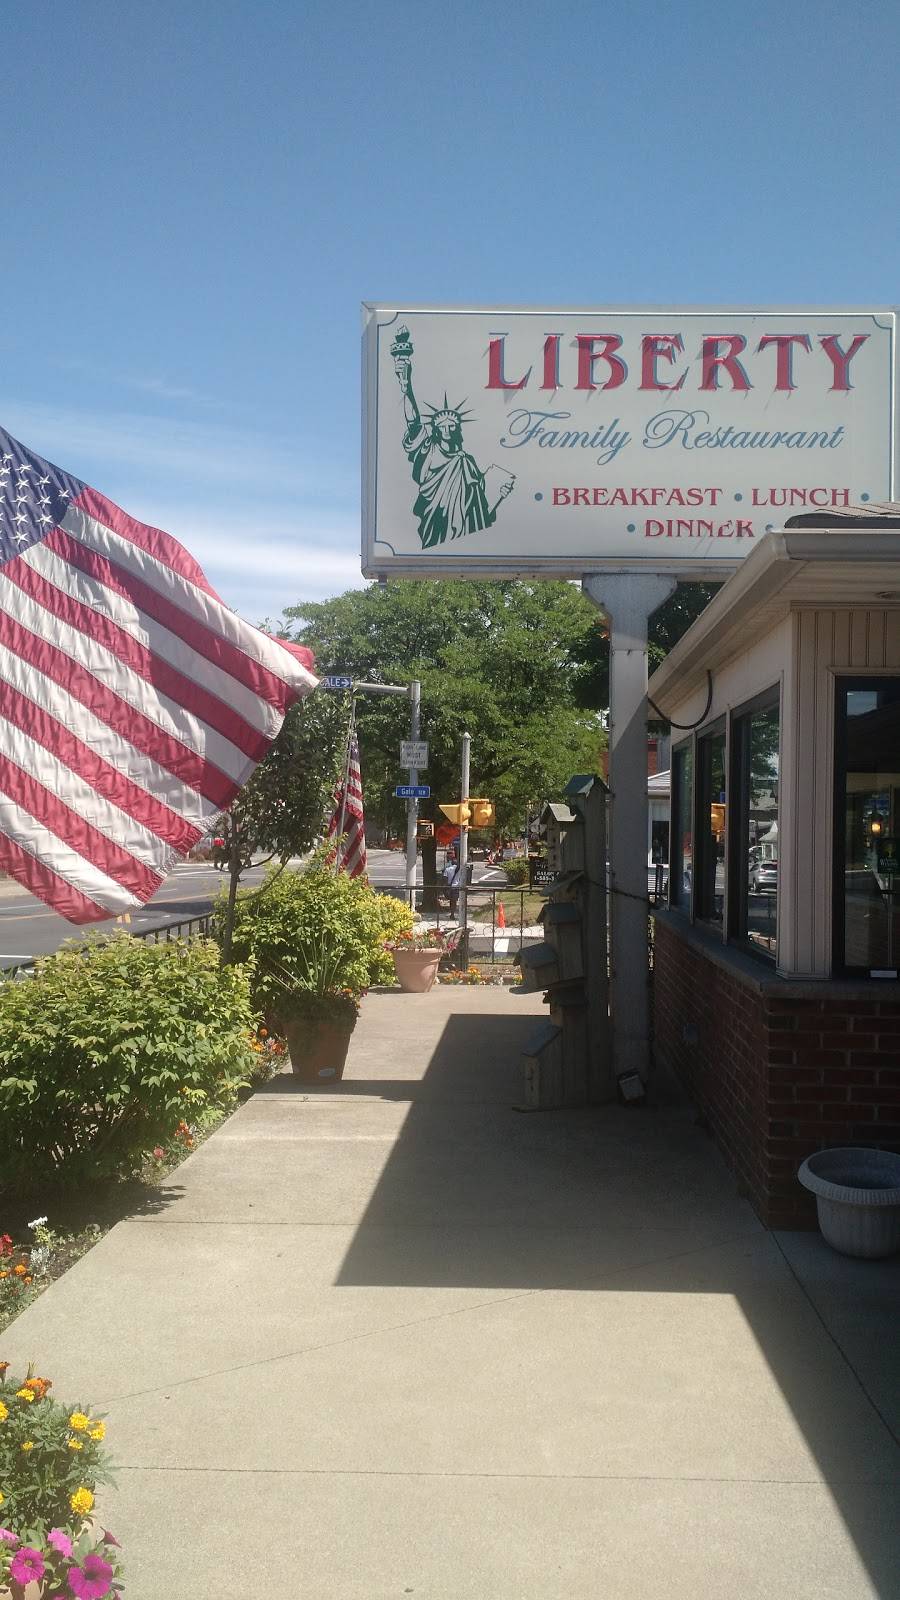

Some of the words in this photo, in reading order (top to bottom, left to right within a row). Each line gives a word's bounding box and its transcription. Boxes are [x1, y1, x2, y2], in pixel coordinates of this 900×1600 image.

[484, 332, 870, 392] LIBERTY
[500, 408, 632, 466] Family
[643, 409, 845, 450] Restaurant
[552, 488, 723, 506] BREAKFAST
[752, 488, 851, 506] LUNCH
[644, 518, 755, 537] DINNER
